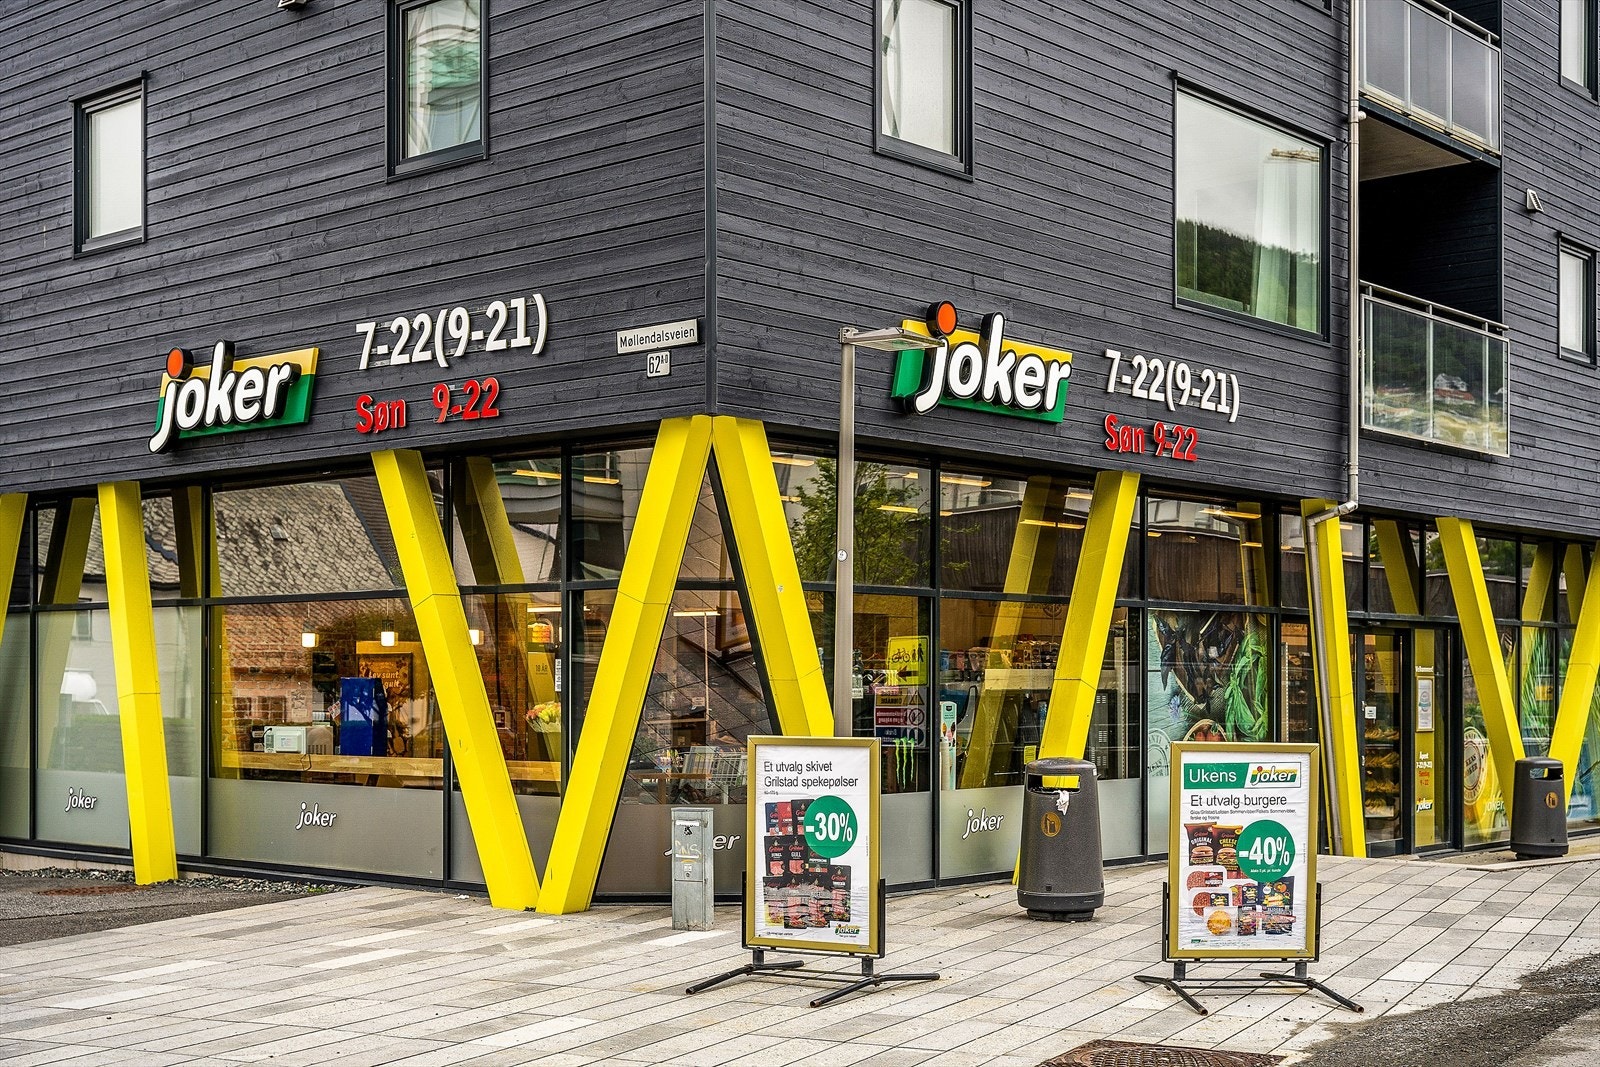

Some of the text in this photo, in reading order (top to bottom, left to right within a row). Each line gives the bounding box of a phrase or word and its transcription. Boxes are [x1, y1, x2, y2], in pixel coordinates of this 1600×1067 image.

[355, 294, 548, 370] 7-22(9-21)
[620, 327, 695, 348] Møllendalsveien
[914, 300, 1072, 415] joker
[148, 338, 295, 453] joker
[1105, 349, 1240, 423] 7-22(9-21)
[355, 377, 499, 434] Søn 9-22
[1105, 414, 1198, 461] Søn 9-22
[764, 761, 833, 774] Et utvalg skivet
[764, 776, 859, 789] Grilstad spekepølser
[1189, 765, 1295, 786] Ukens joker
[65, 787, 97, 812] joker
[1190, 794, 1287, 809] Et utvalg burgere
[295, 801, 337, 830] joker
[805, 812, 853, 842] -30%
[962, 807, 1004, 840] joker
[1238, 836, 1290, 866] -40%
